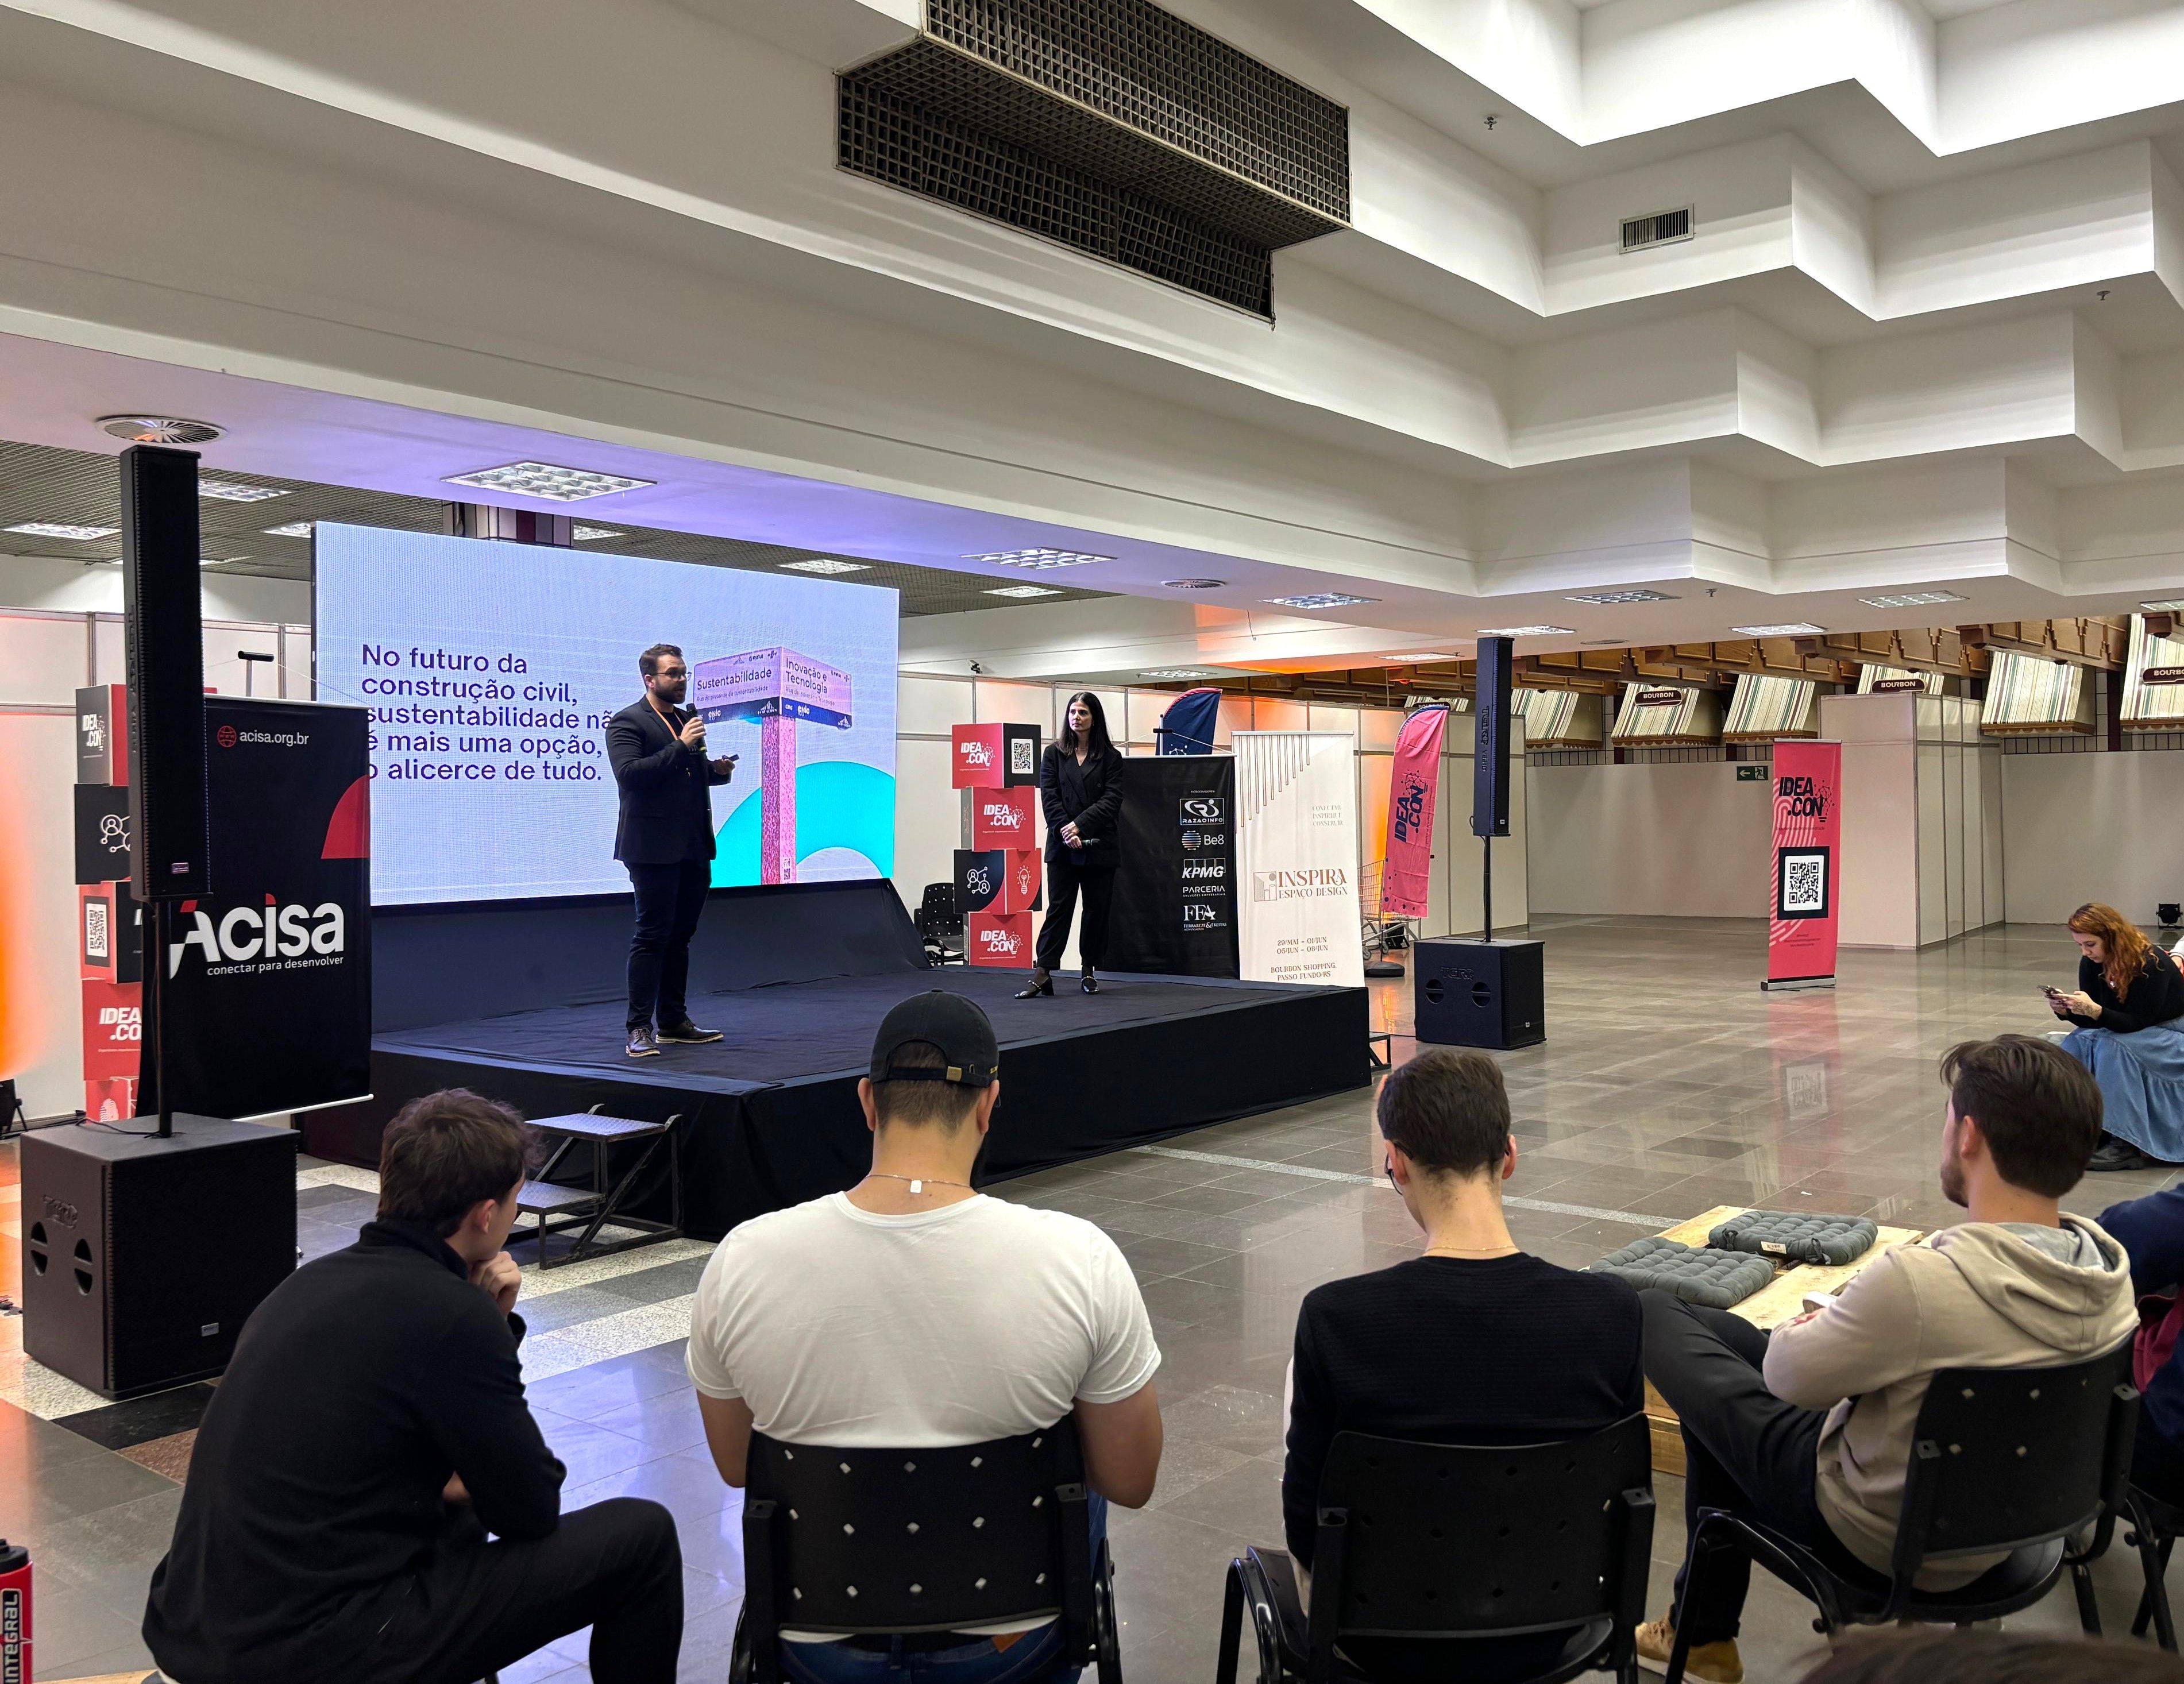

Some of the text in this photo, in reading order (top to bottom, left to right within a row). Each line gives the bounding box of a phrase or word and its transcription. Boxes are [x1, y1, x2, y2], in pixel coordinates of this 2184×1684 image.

[362, 644, 527, 674] No futuro da
[697, 667, 772, 690] Sustentabilidade
[786, 657, 821, 679] Inovação
[822, 674, 827, 682] e
[362, 677, 577, 706] construção civil,
[785, 671, 827, 694] Tecnologia
[82, 714, 98, 731] IDEA
[368, 704, 612, 729] sustentabilidade nã
[240, 729, 310, 747] acisa.org.br
[368, 730, 602, 759] é mais uma opção,
[960, 741, 983, 754] IDEA
[388, 759, 496, 781] alicerce
[504, 761, 535, 780] de
[543, 761, 602, 781] tudo.
[1778, 777, 1814, 797] IDEA
[983, 804, 1010, 815] IDEA
[1394, 797, 1410, 843] IDEA
[1203, 834, 1225, 845] Be8
[1182, 866, 1224, 879] KPMG
[1278, 868, 1347, 887] INSPIRA
[1183, 885, 1226, 893] PARCERIA
[1279, 886, 1348, 899] ESPAÇO DESIGN
[1183, 905, 1216, 921] FFA
[981, 930, 1007, 941] IDEA
[1307, 936, 1328, 944] 01/JUN
[207, 956, 344, 975] conectar para desenvolver
[1271, 964, 1302, 974] BOURBON
[1299, 971, 1331, 979] FUNDO/RS
[99, 1007, 141, 1025] IDEA
[110, 1024, 142, 1041] .CO
